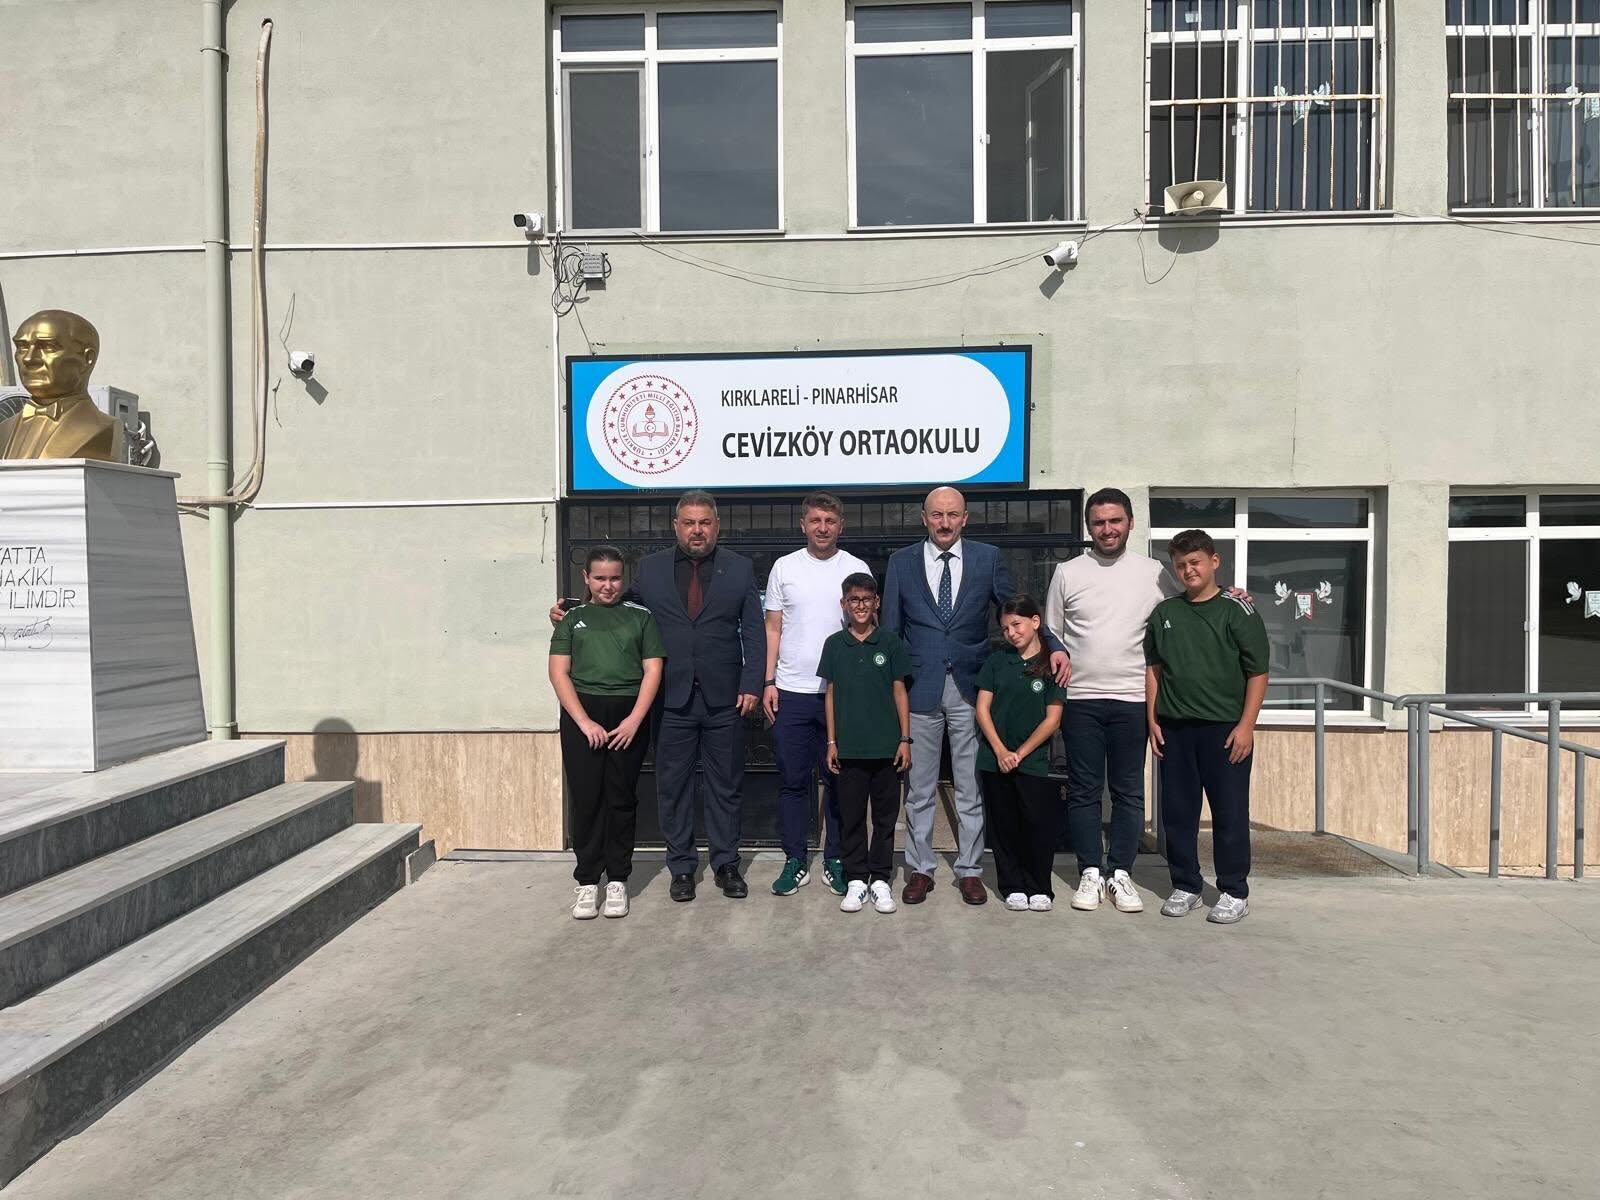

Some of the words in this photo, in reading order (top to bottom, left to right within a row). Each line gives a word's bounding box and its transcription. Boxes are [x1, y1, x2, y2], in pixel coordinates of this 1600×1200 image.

[721, 385, 800, 407] KIRKLARELİ
[812, 383, 898, 405] PINARHİSAR
[722, 425, 834, 458] CEVİZKÖY
[840, 428, 980, 455] ORTAOKULU
